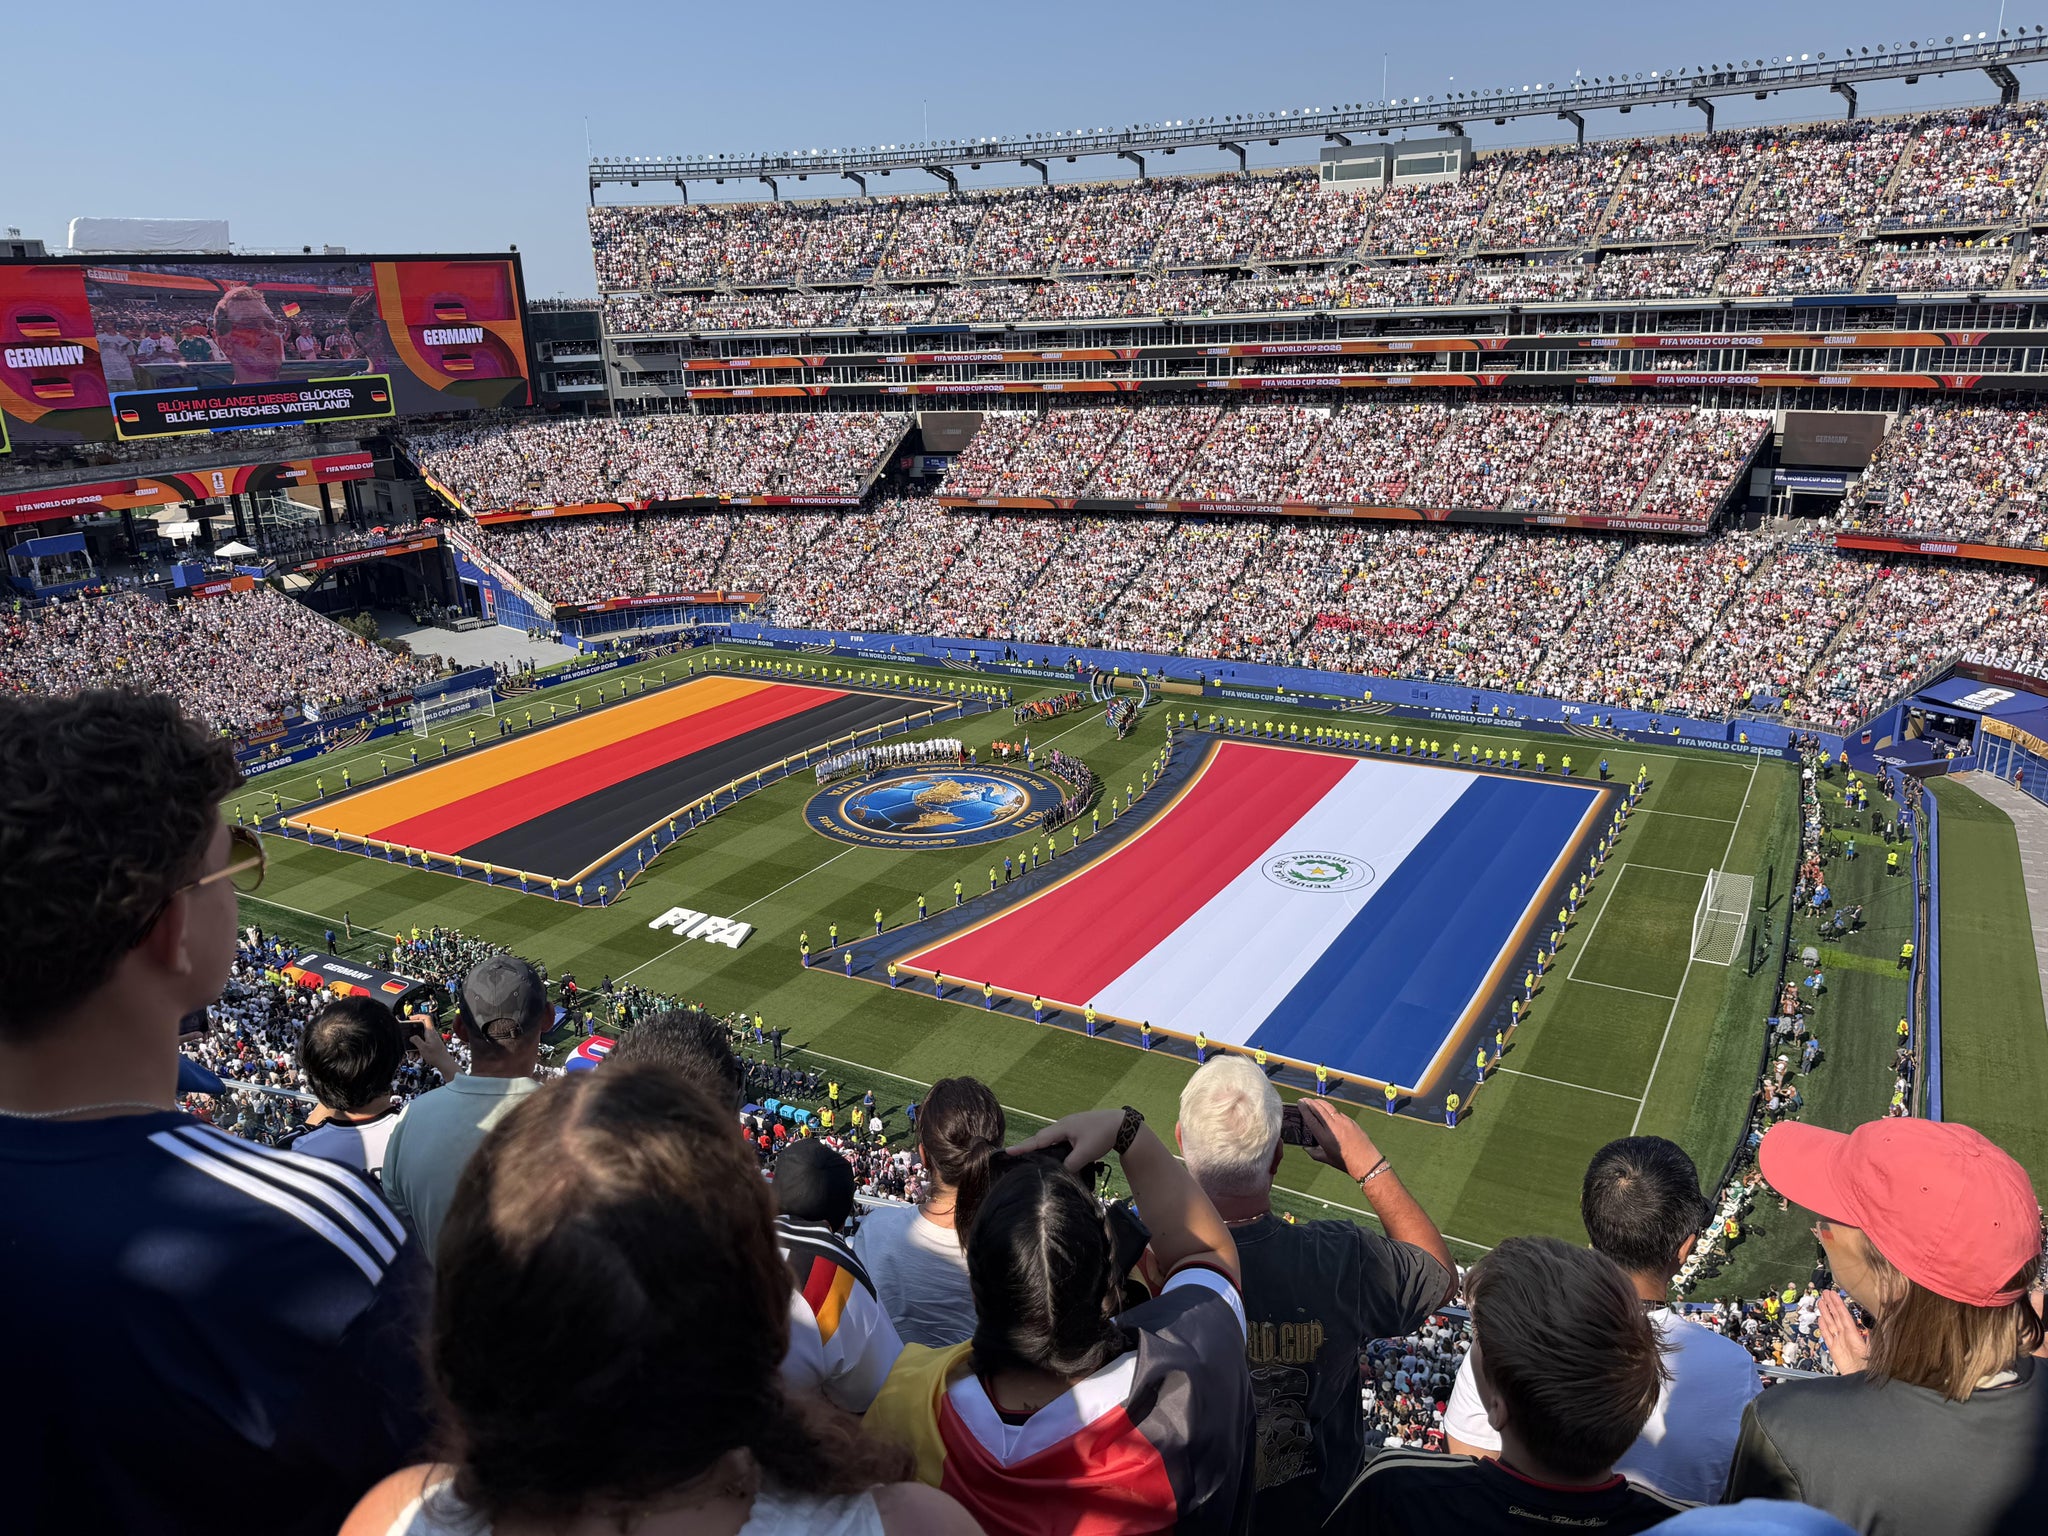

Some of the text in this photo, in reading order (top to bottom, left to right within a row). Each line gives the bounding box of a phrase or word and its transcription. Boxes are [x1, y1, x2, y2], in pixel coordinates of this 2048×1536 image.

[88, 269, 129, 282] GERMANY
[423, 328, 484, 346] GERMANY
[1824, 336, 1856, 344] GERMANY
[1389, 342, 1414, 350] GERMANY
[5, 346, 84, 368] GERMANY
[1387, 377, 1411, 385] GERMANY
[1819, 376, 1851, 384] GERMANY
[158, 388, 354, 412] BLÜH IM GLANZE DIESES GLÜCKES,
[165, 399, 350, 423] BLÜHE, DEUTSCHES VATERLAND!
[1816, 435, 1848, 444] GERMANY
[326, 465, 339, 473] FIFA
[340, 463, 361, 471] WORLD
[16, 495, 103, 512] FIFA WORLD CUP 2026
[1216, 504, 1241, 512] WORLD
[1256, 505, 1282, 513] 2026
[1328, 507, 1354, 515] GERMANY
[1536, 515, 1566, 524] GERMANY
[1607, 520, 1706, 532] FIFA WORLD CUP 202
[1920, 542, 1957, 553] GERMANY
[344, 554, 361, 562] WORLD
[361, 552, 371, 560] CUP
[371, 549, 387, 557] 2026
[1961, 648, 2014, 670] NEUSS
[575, 669, 590, 679] WORLD
[591, 667, 600, 675] CUP
[600, 662, 618, 672] 2026
[1055, 672, 1074, 680] 2026
[1132, 680, 1160, 689] BOON
[1238, 691, 1260, 699] WORLD
[1275, 696, 1298, 704] 2026
[416, 712, 438, 724] WRLD
[450, 703, 470, 713] 2026
[1562, 705, 1581, 714] FIFA
[1448, 713, 1476, 723] WORLD
[1477, 716, 1492, 725] CUP
[1493, 718, 1522, 727] 2026
[1678, 737, 1782, 756] FIFA WORLD CUP 2026
[252, 764, 266, 773] CUP
[267, 756, 292, 768] 2026
[992, 770, 1032, 782] WORLD
[826, 781, 864, 796] FIFA
[1029, 780, 1047, 790] FIFA
[1012, 811, 1044, 828] FIFA
[818, 816, 834, 828] FIFA
[832, 826, 871, 840] WORLD
[1291, 854, 1353, 864] PARAGUAY
[649, 907, 752, 949] FIFA
[323, 963, 373, 980] GERMANY
[1279, 1320, 1324, 1364] CUP
